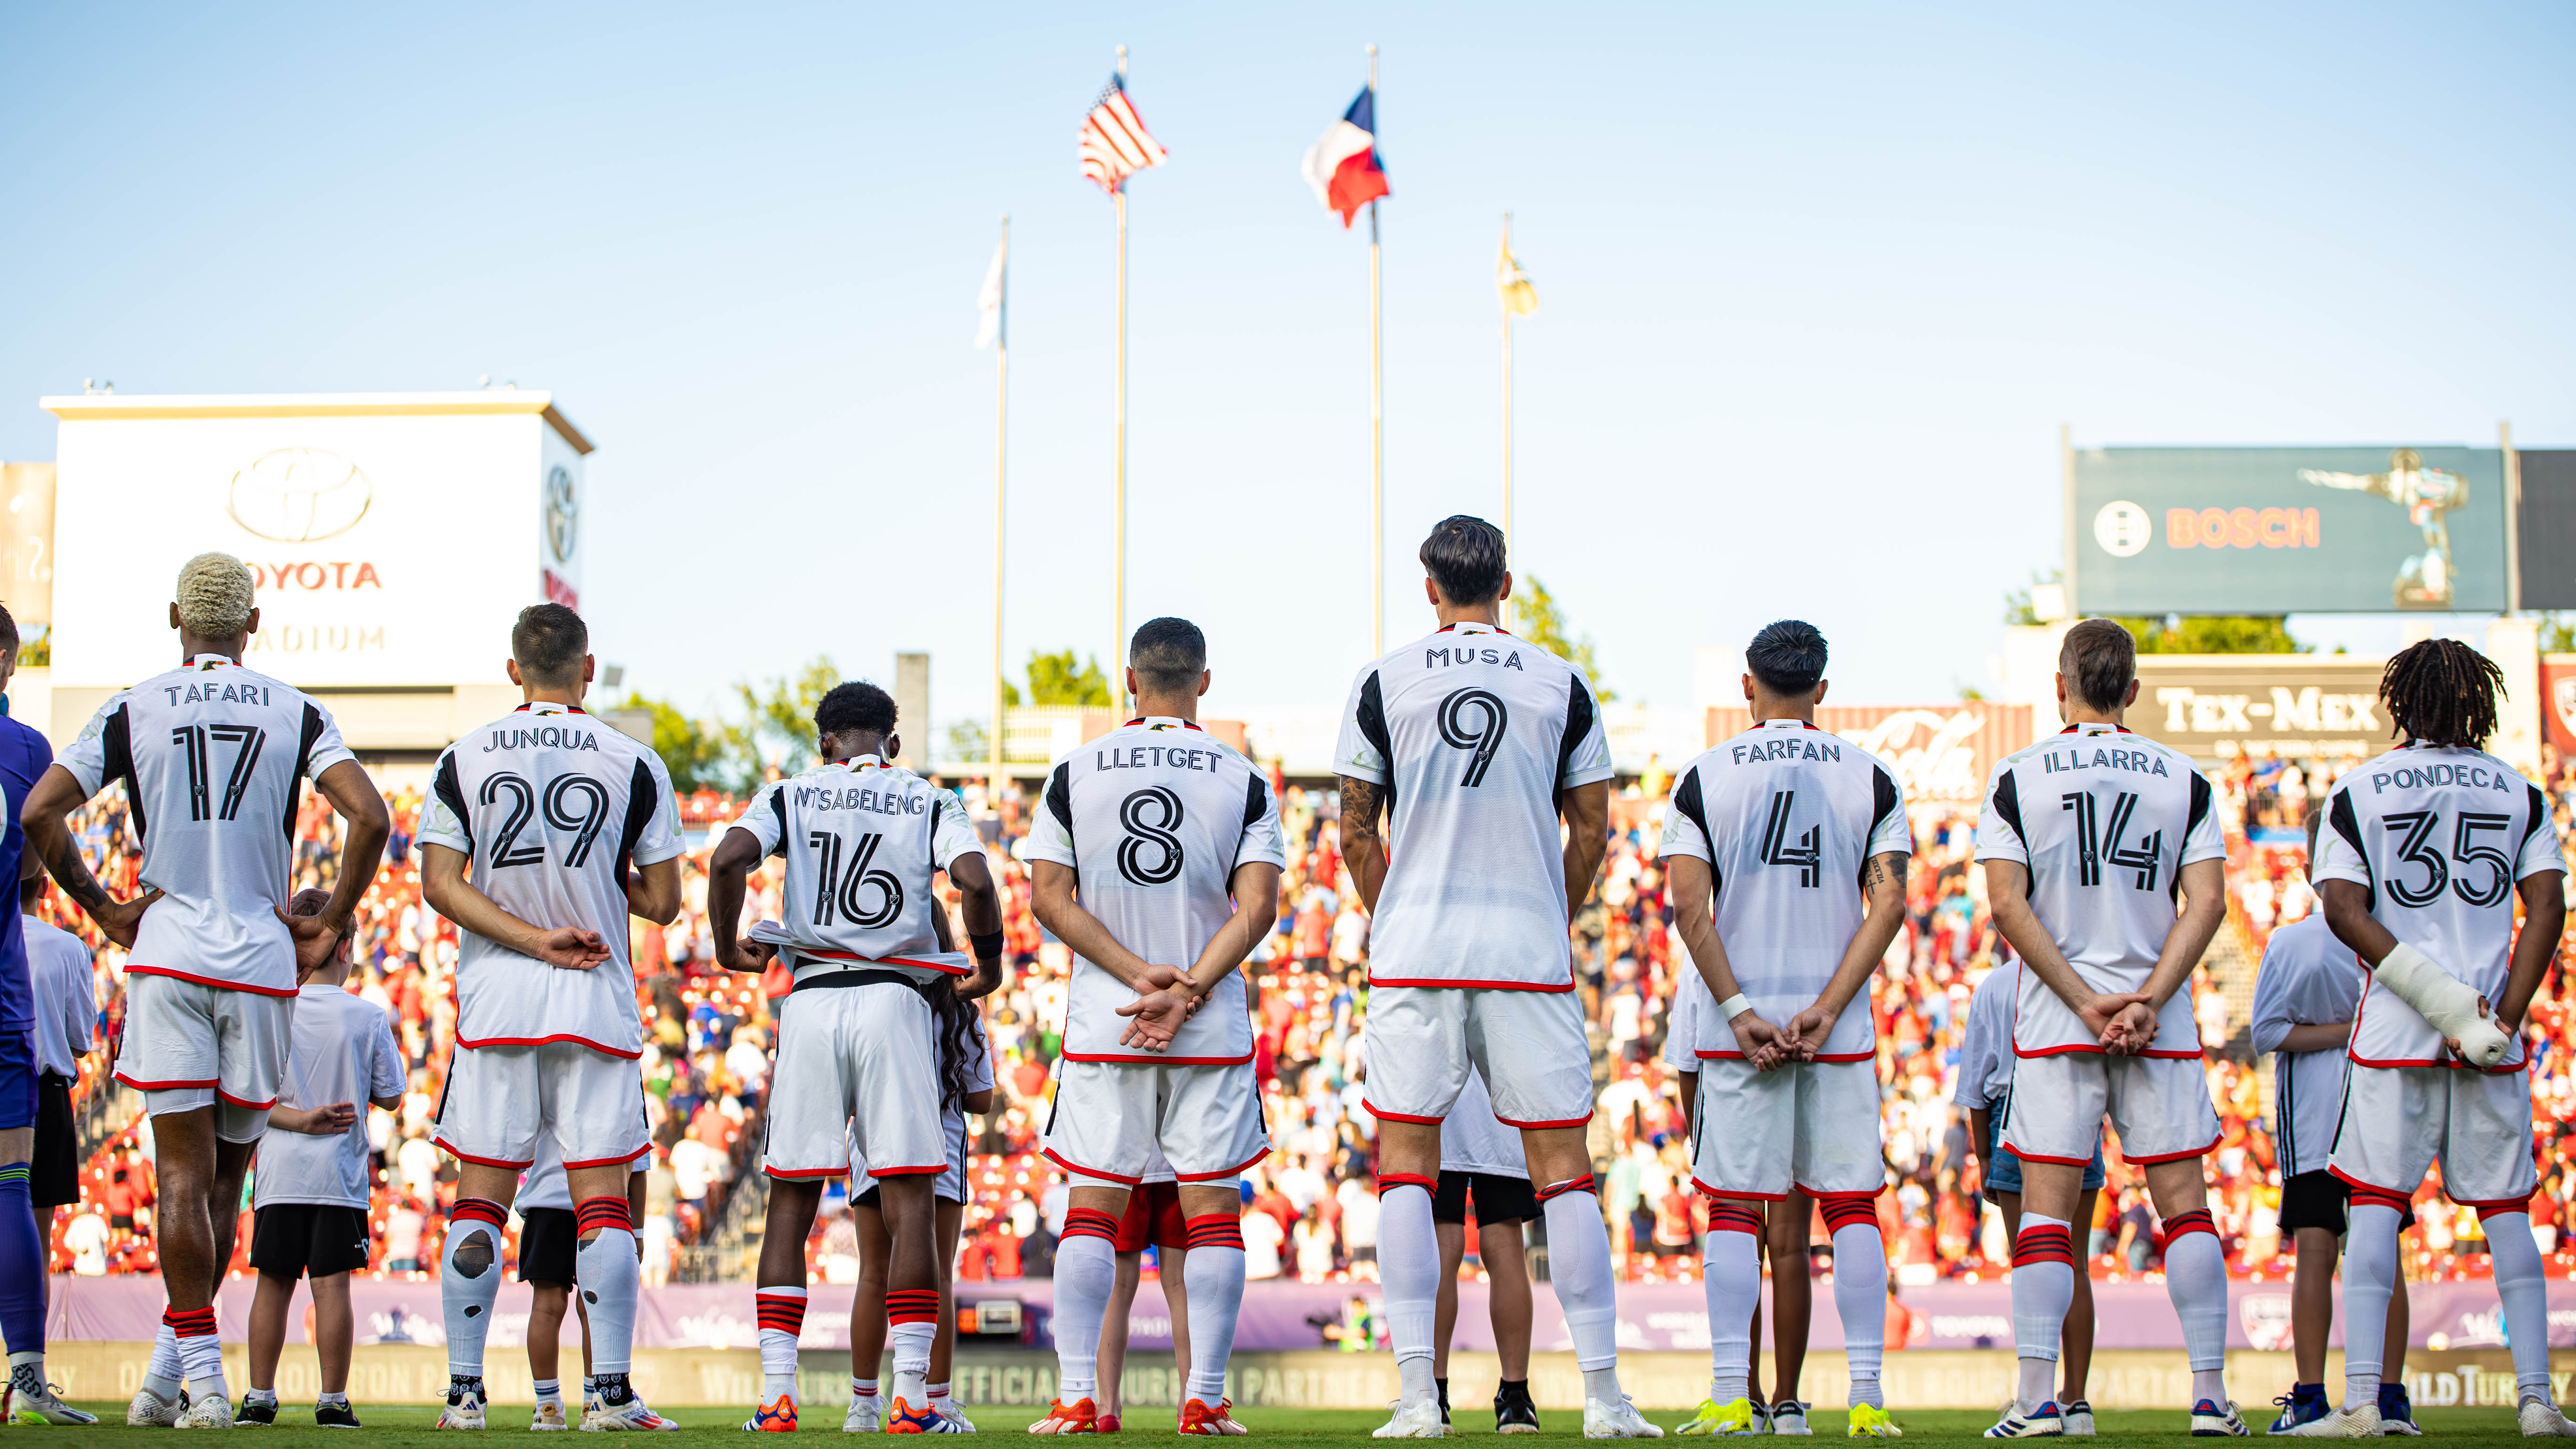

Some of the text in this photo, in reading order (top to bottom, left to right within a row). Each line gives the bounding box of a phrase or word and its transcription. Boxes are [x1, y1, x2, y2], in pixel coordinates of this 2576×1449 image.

[2166, 507, 2319, 549] BOSCH
[245, 562, 382, 590] OYOTA
[252, 626, 385, 652] ADIUM
[1426, 648, 1523, 671] MUSA
[164, 683, 269, 707] TAFARI
[483, 726, 599, 752] JUNQUA
[1437, 686, 1508, 788] 9
[1732, 738, 1840, 765] FARFAN
[172, 724, 266, 821] 17
[1097, 747, 1222, 773] LLETGET
[2044, 749, 2168, 778] ILLARRA
[2373, 764, 2511, 794] PONDECA
[480, 771, 610, 869] 29
[795, 786, 924, 815] NTSABELENG
[1117, 785, 1184, 887] 8
[1761, 790, 1820, 888] 4
[2062, 790, 2162, 891] 14
[2382, 811, 2512, 908] 35
[810, 831, 904, 929] 16
[700, 1364, 762, 1405] WIL
[953, 1367, 1055, 1406] FFICIAL
[1240, 1367, 1388, 1407] PARTNER
[2402, 1365, 2573, 1407] ILD TURY
